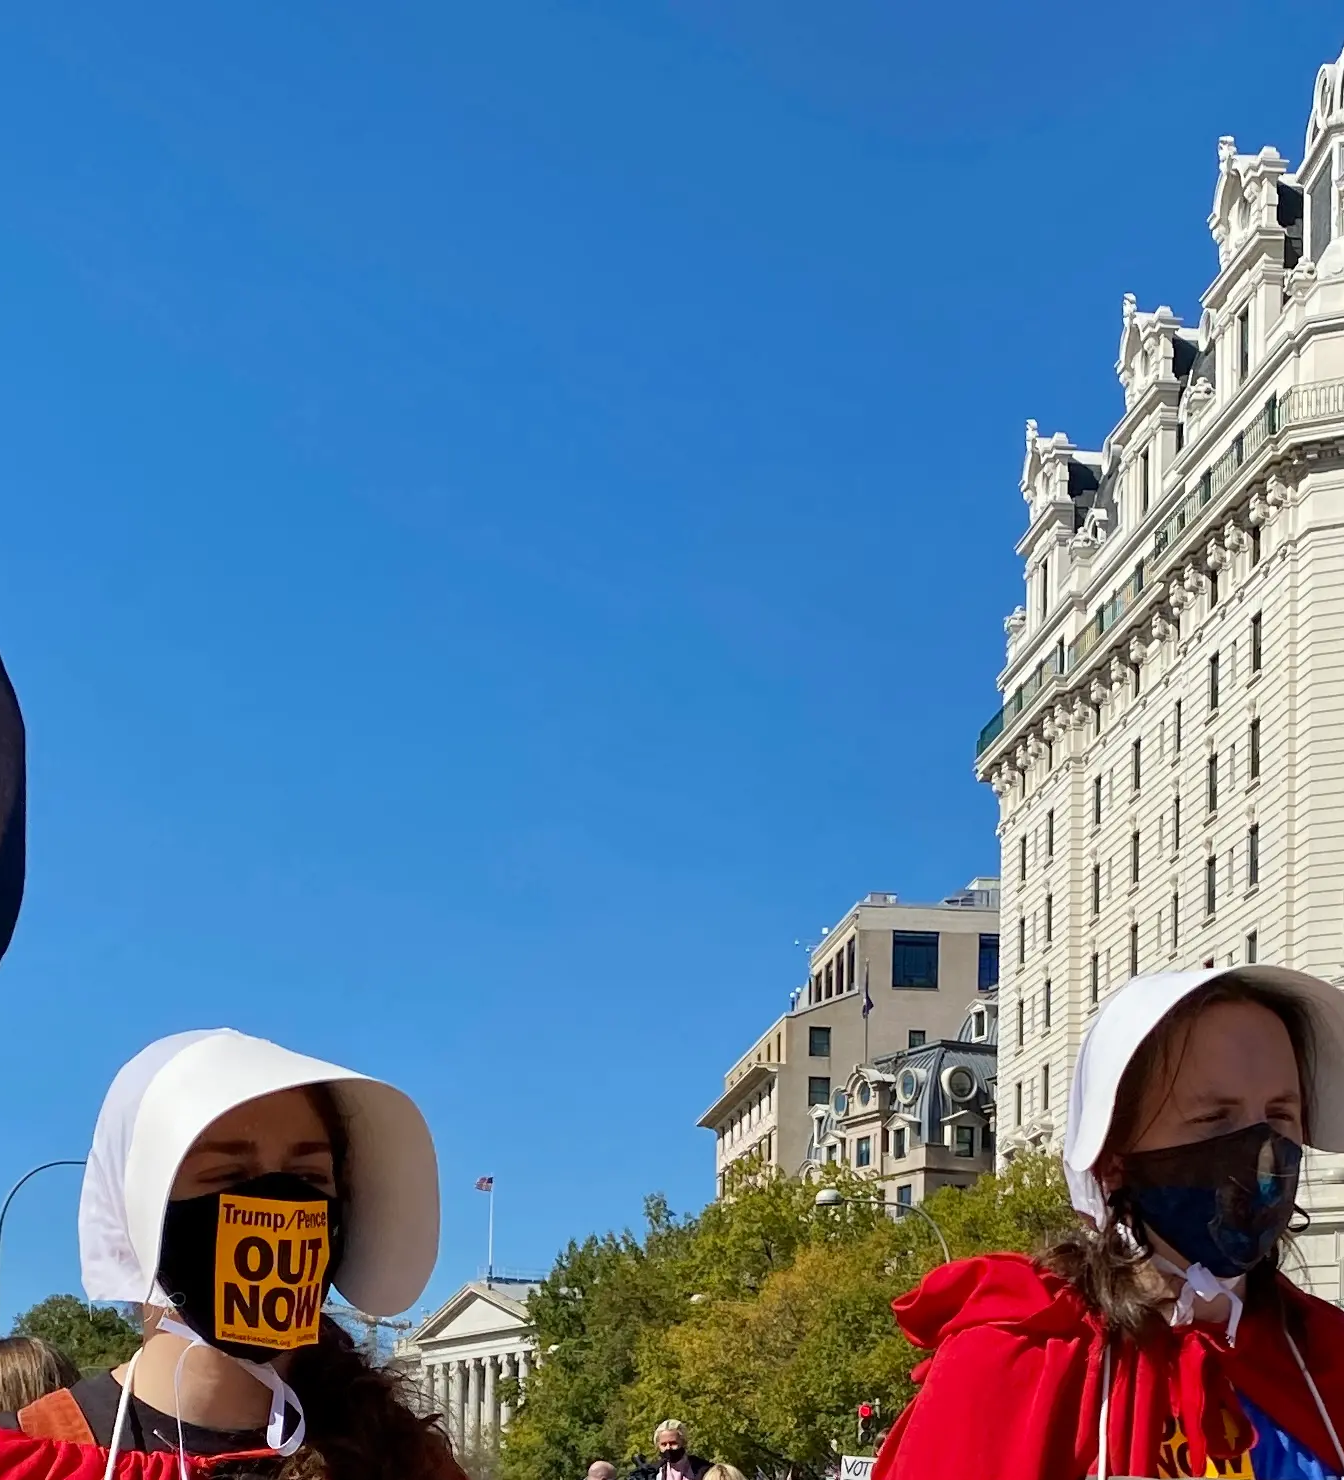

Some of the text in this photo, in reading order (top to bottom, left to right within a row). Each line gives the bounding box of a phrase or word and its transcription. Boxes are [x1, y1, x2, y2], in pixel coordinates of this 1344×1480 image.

[222, 1203, 327, 1232] Trump/Pence
[233, 1235, 323, 1285] OUT
[223, 1281, 320, 1332] NOW
